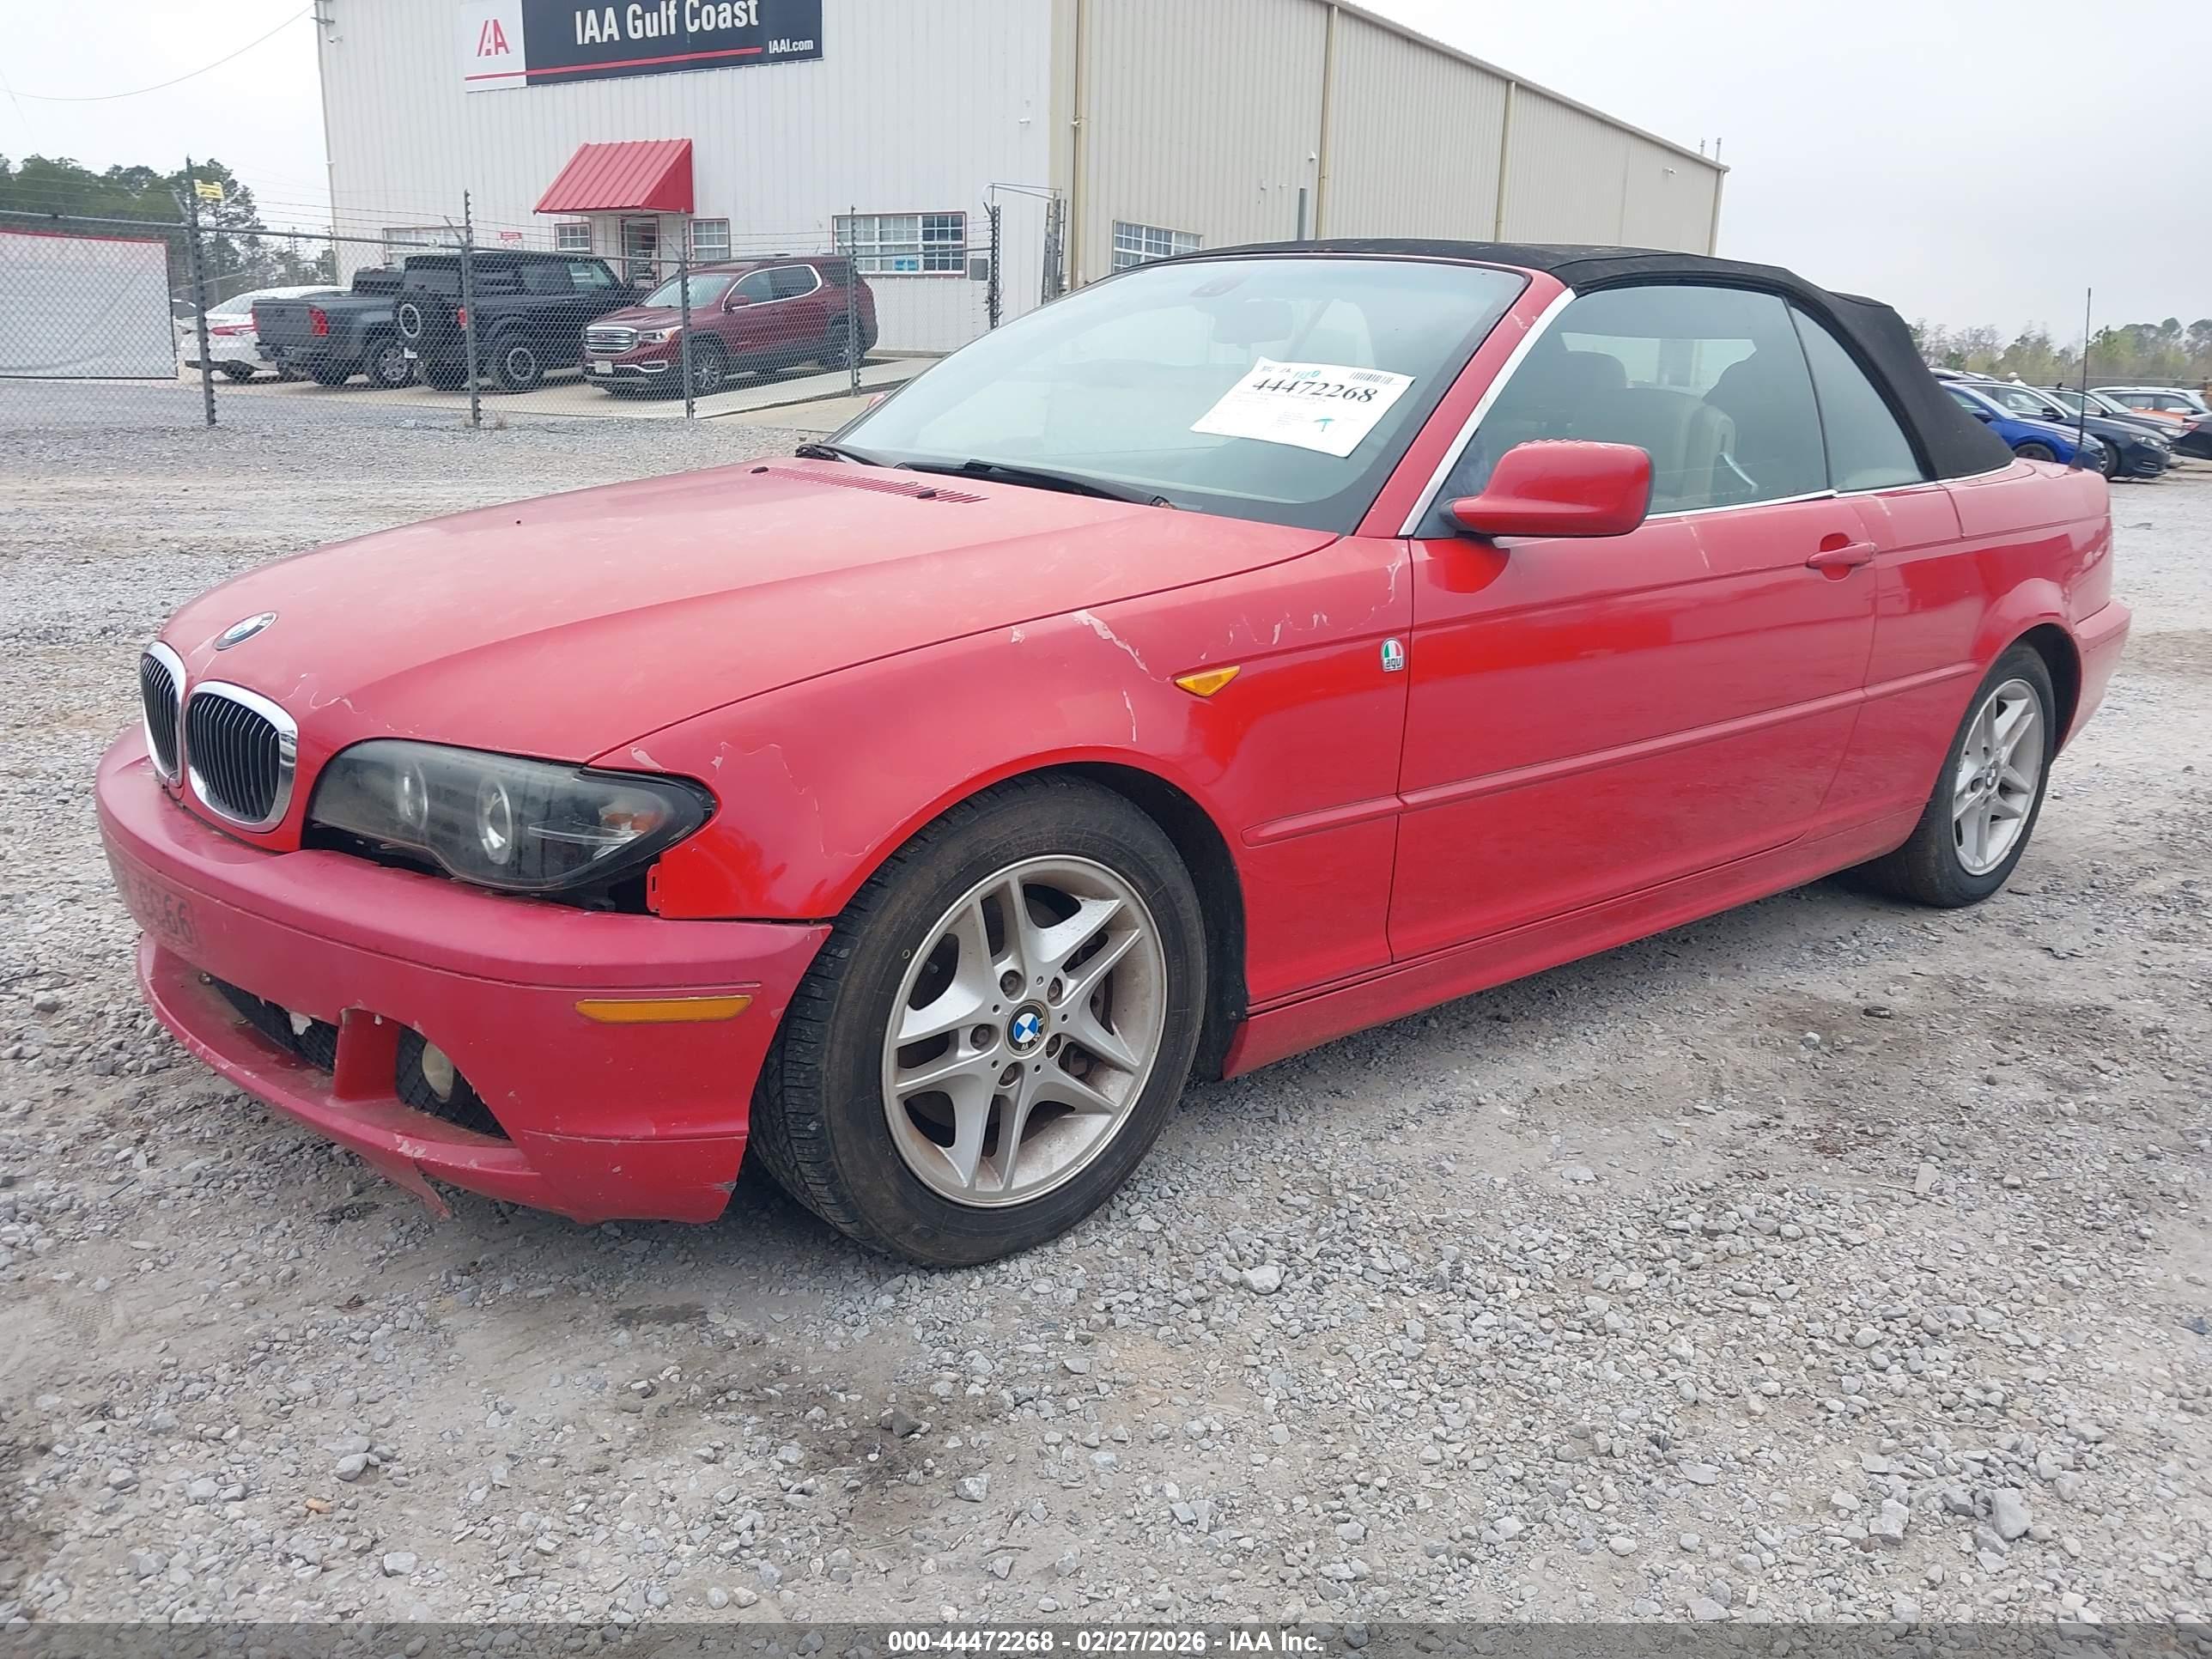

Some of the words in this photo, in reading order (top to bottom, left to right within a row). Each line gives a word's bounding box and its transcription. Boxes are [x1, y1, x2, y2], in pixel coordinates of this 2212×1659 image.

[574, 7, 620, 45] IAA
[626, 0, 677, 40] Gulf
[685, 0, 759, 33] Coast
[769, 38, 814, 54] IAAI.com
[1252, 378, 1378, 403] 44472268
